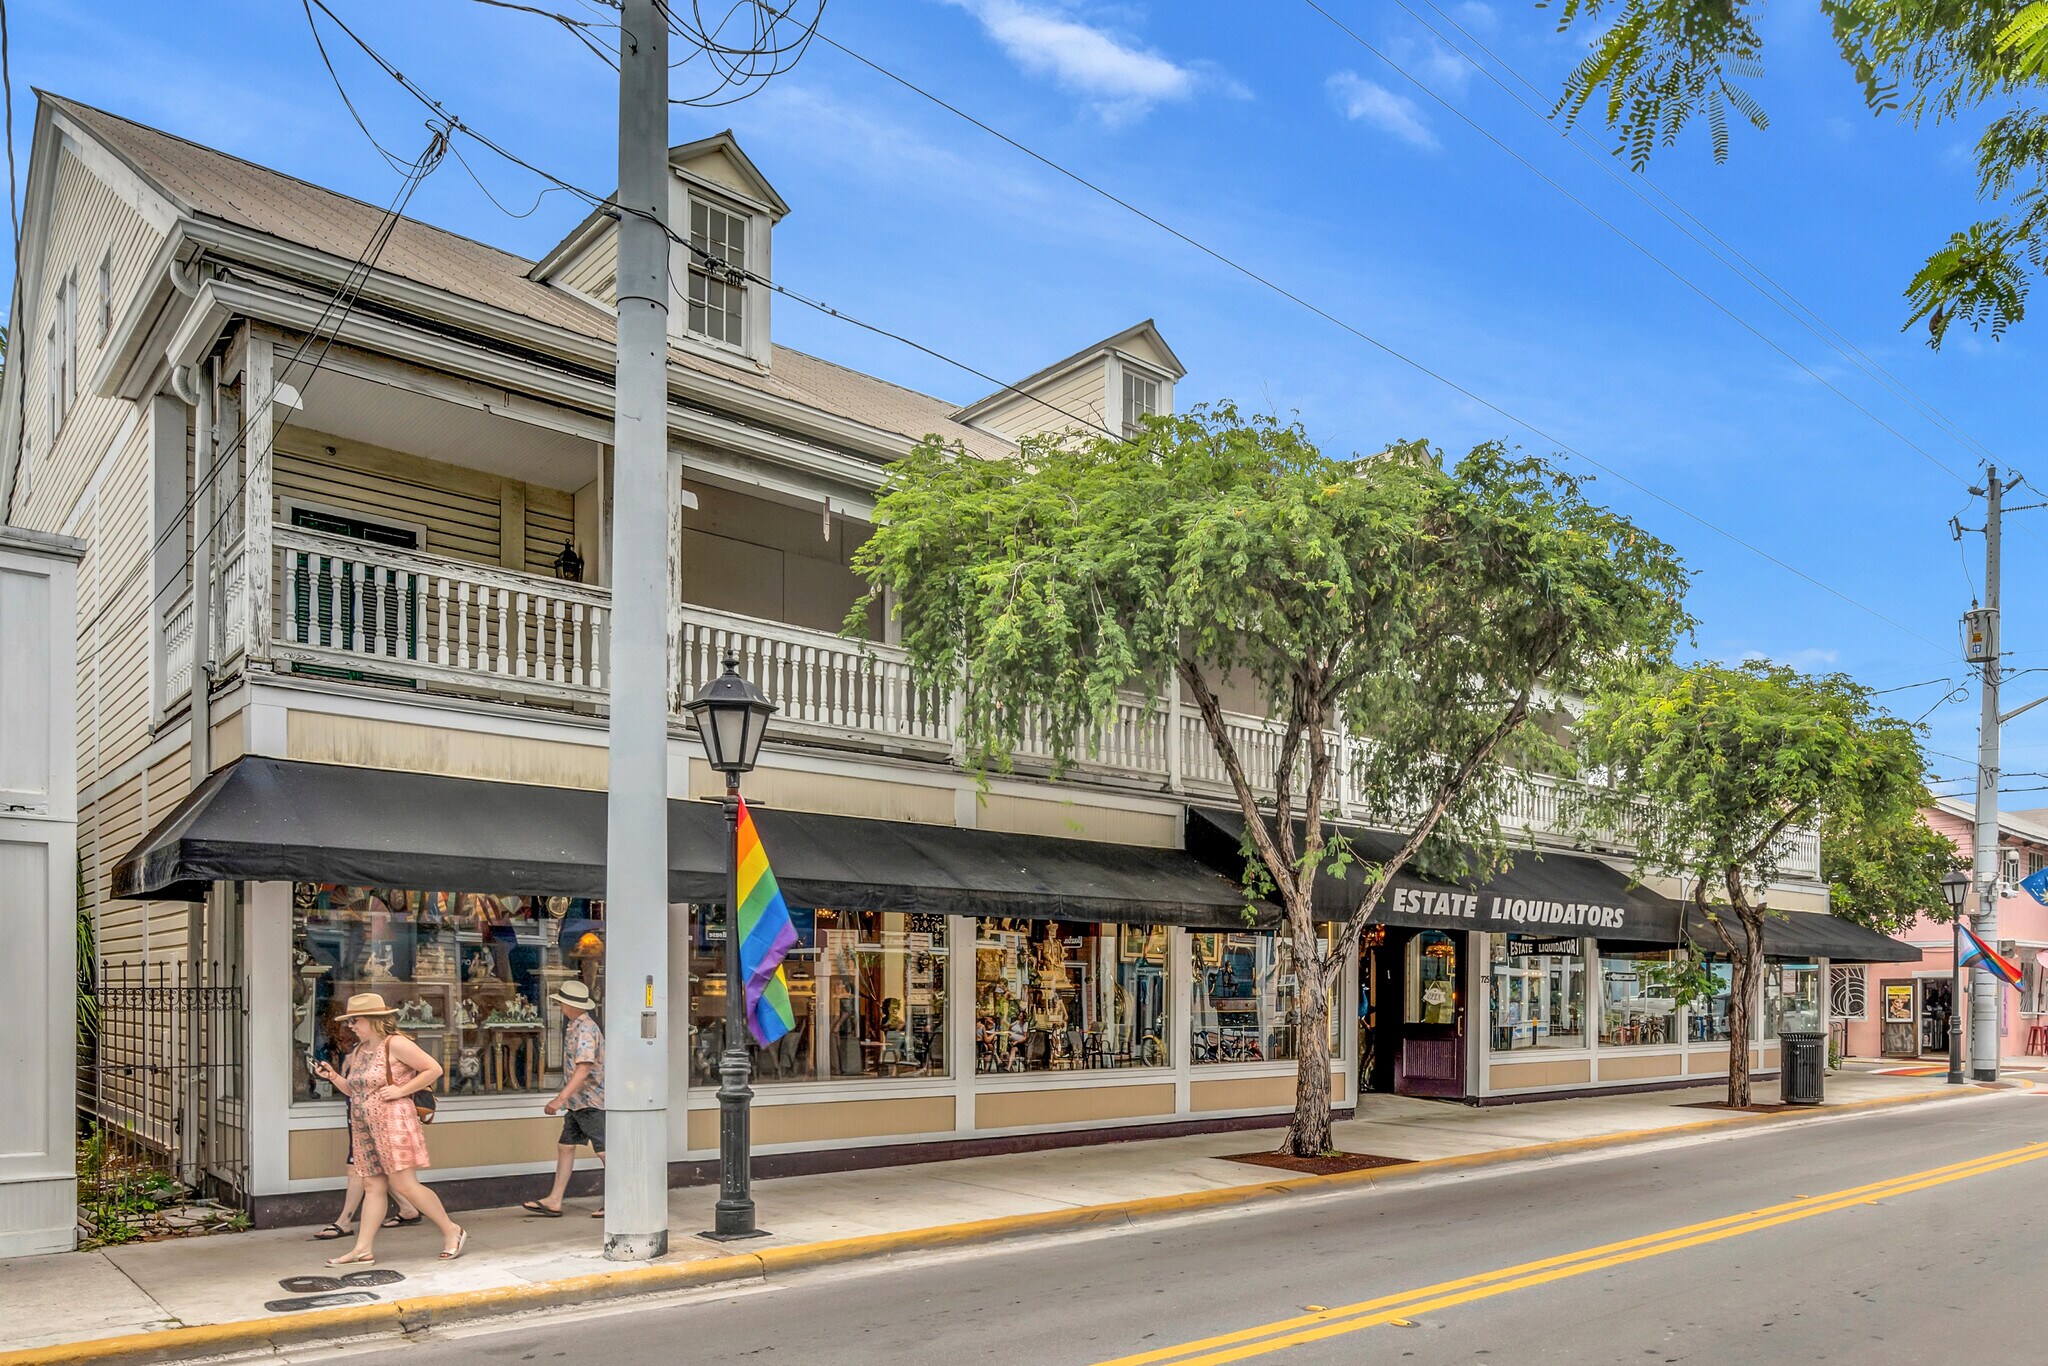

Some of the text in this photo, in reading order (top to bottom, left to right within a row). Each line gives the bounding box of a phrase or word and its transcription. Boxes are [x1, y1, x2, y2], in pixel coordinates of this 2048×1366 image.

[1393, 888, 1625, 928] ESTATE LIQUIDATORS
[1510, 941, 1533, 956] ESTATE
[1480, 975, 1490, 984] 725
